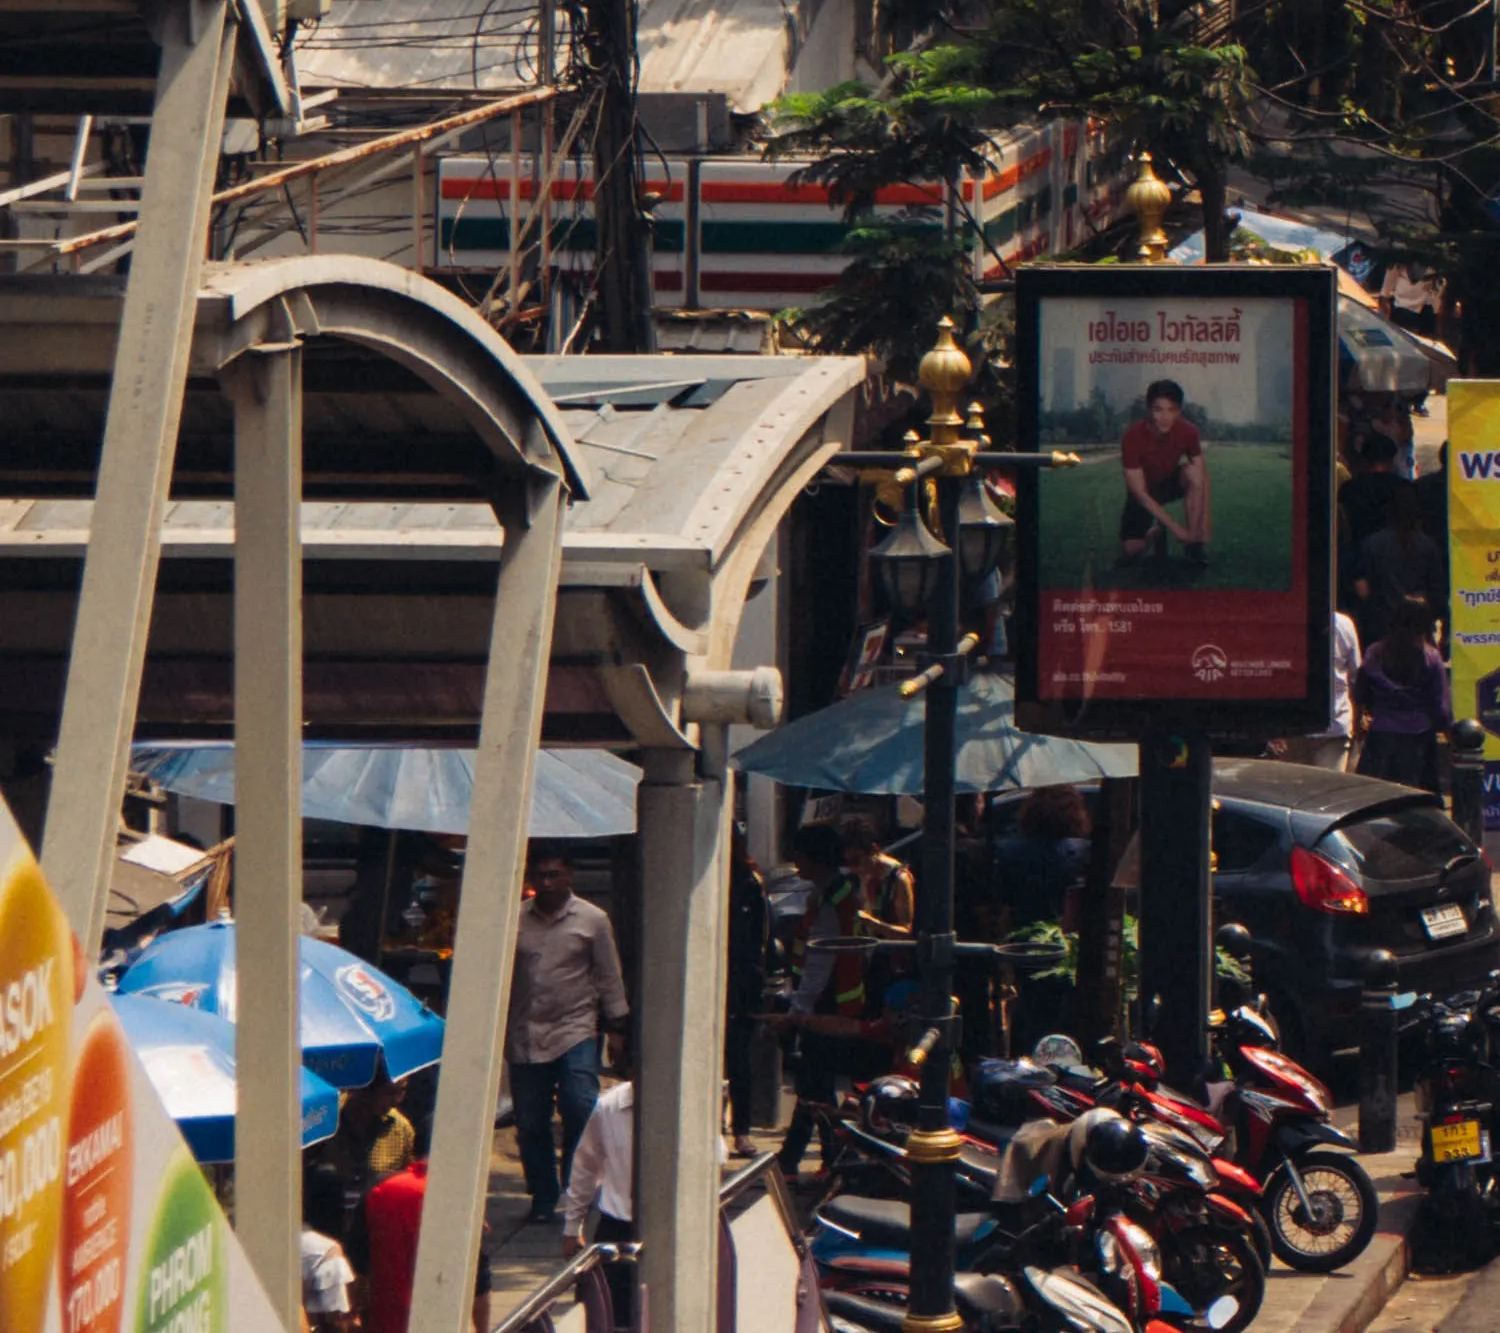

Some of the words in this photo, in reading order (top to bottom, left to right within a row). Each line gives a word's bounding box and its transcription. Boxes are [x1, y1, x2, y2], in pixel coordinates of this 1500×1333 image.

[1088, 311, 1149, 342] เอไอเอ
[150, 1221, 213, 1325] PHROM
